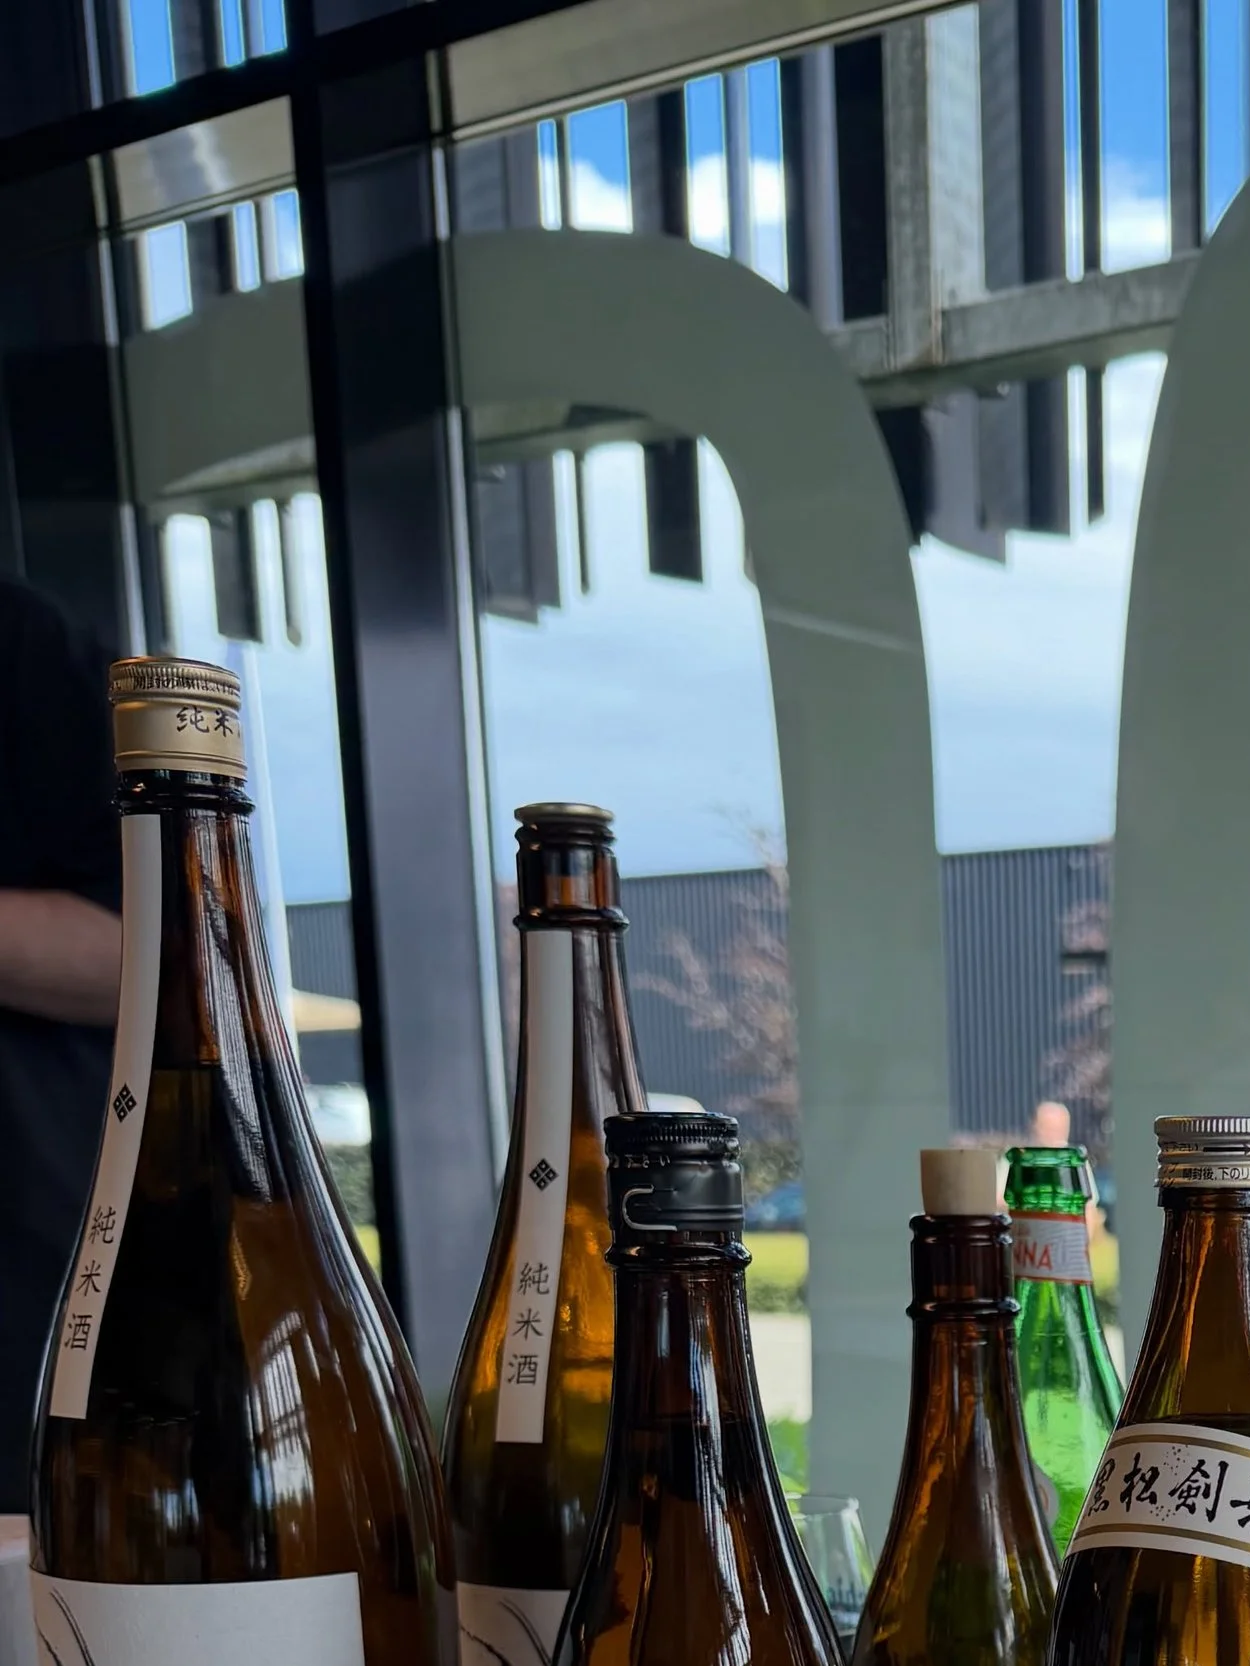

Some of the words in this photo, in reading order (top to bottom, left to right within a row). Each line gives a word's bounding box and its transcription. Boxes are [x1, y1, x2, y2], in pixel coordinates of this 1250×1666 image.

[176, 706, 241, 738] 純米
[64, 1206, 115, 1352] 純米酒
[507, 1262, 551, 1387] 純米酒
